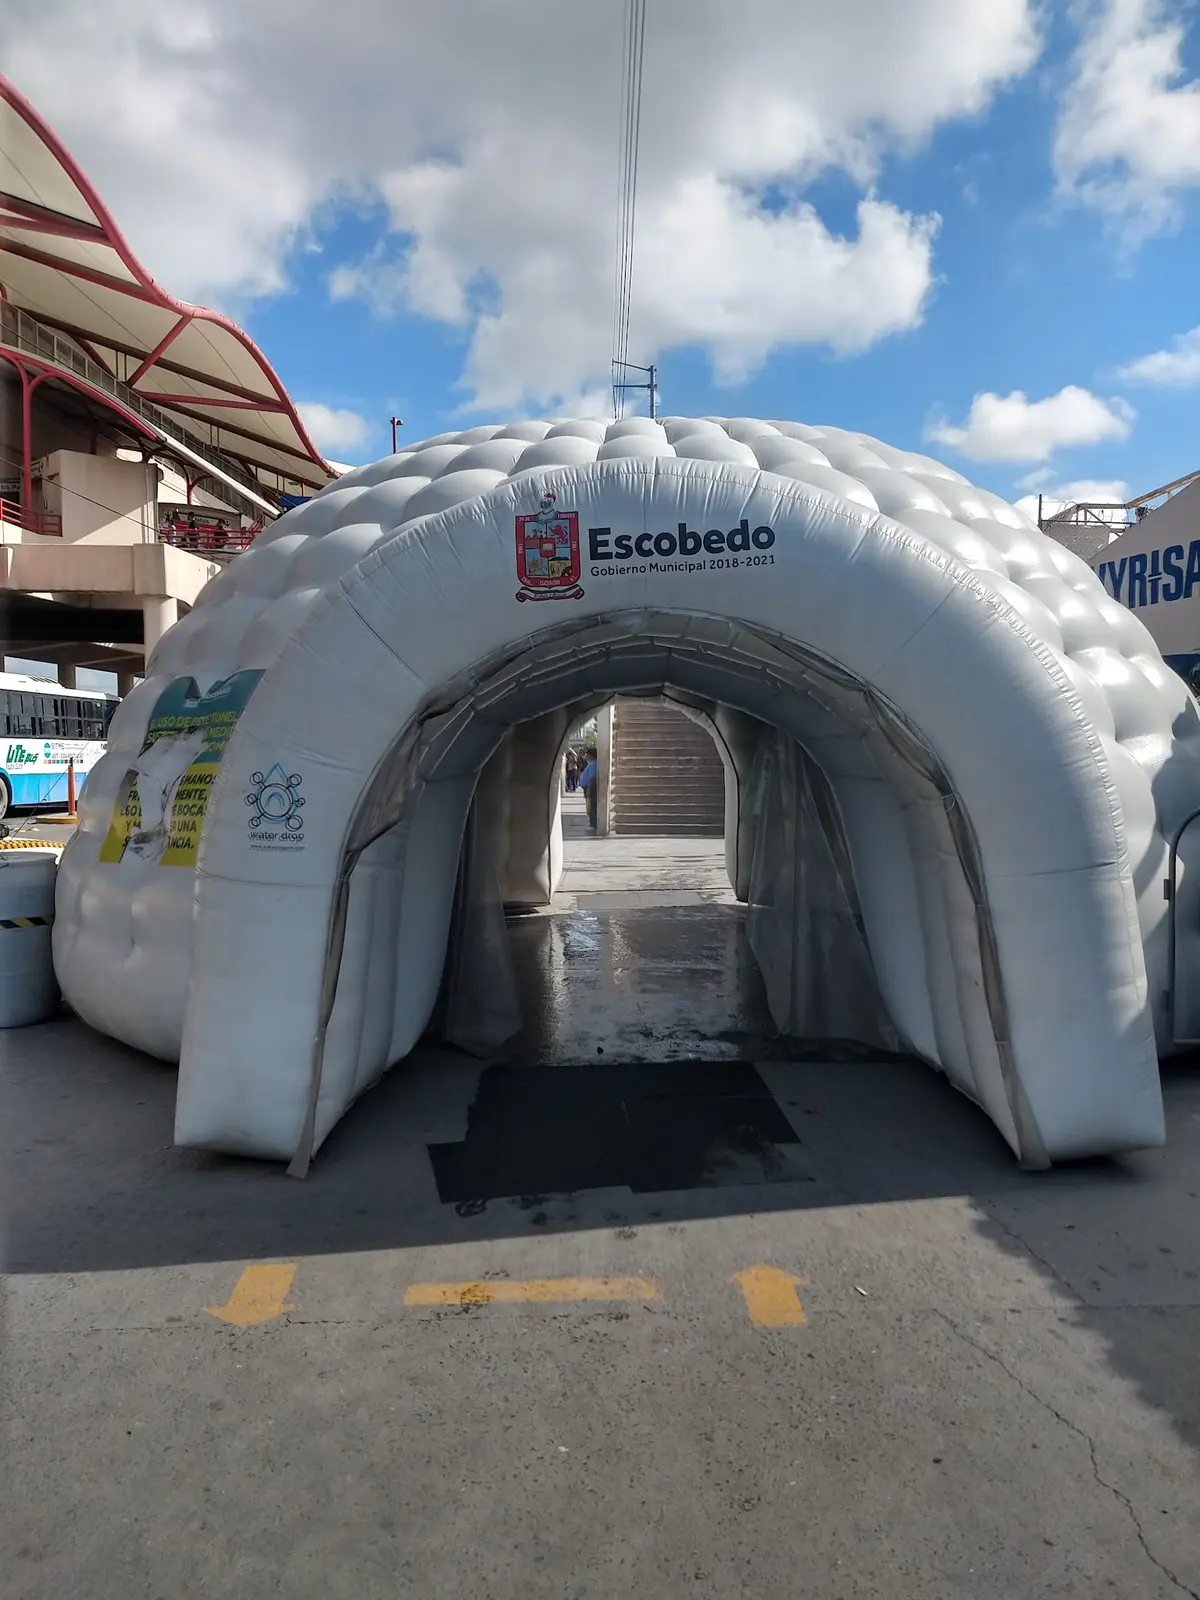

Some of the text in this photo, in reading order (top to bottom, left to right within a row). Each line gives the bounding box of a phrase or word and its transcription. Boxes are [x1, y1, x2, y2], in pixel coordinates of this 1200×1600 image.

[588, 519, 776, 560] Escobedo
[590, 554, 776, 577] Gobierno Municipal 2018-2021
[1091, 540, 1200, 609] YRISA
[179, 820, 197, 833] UNA
[248, 831, 305, 844] water drop
